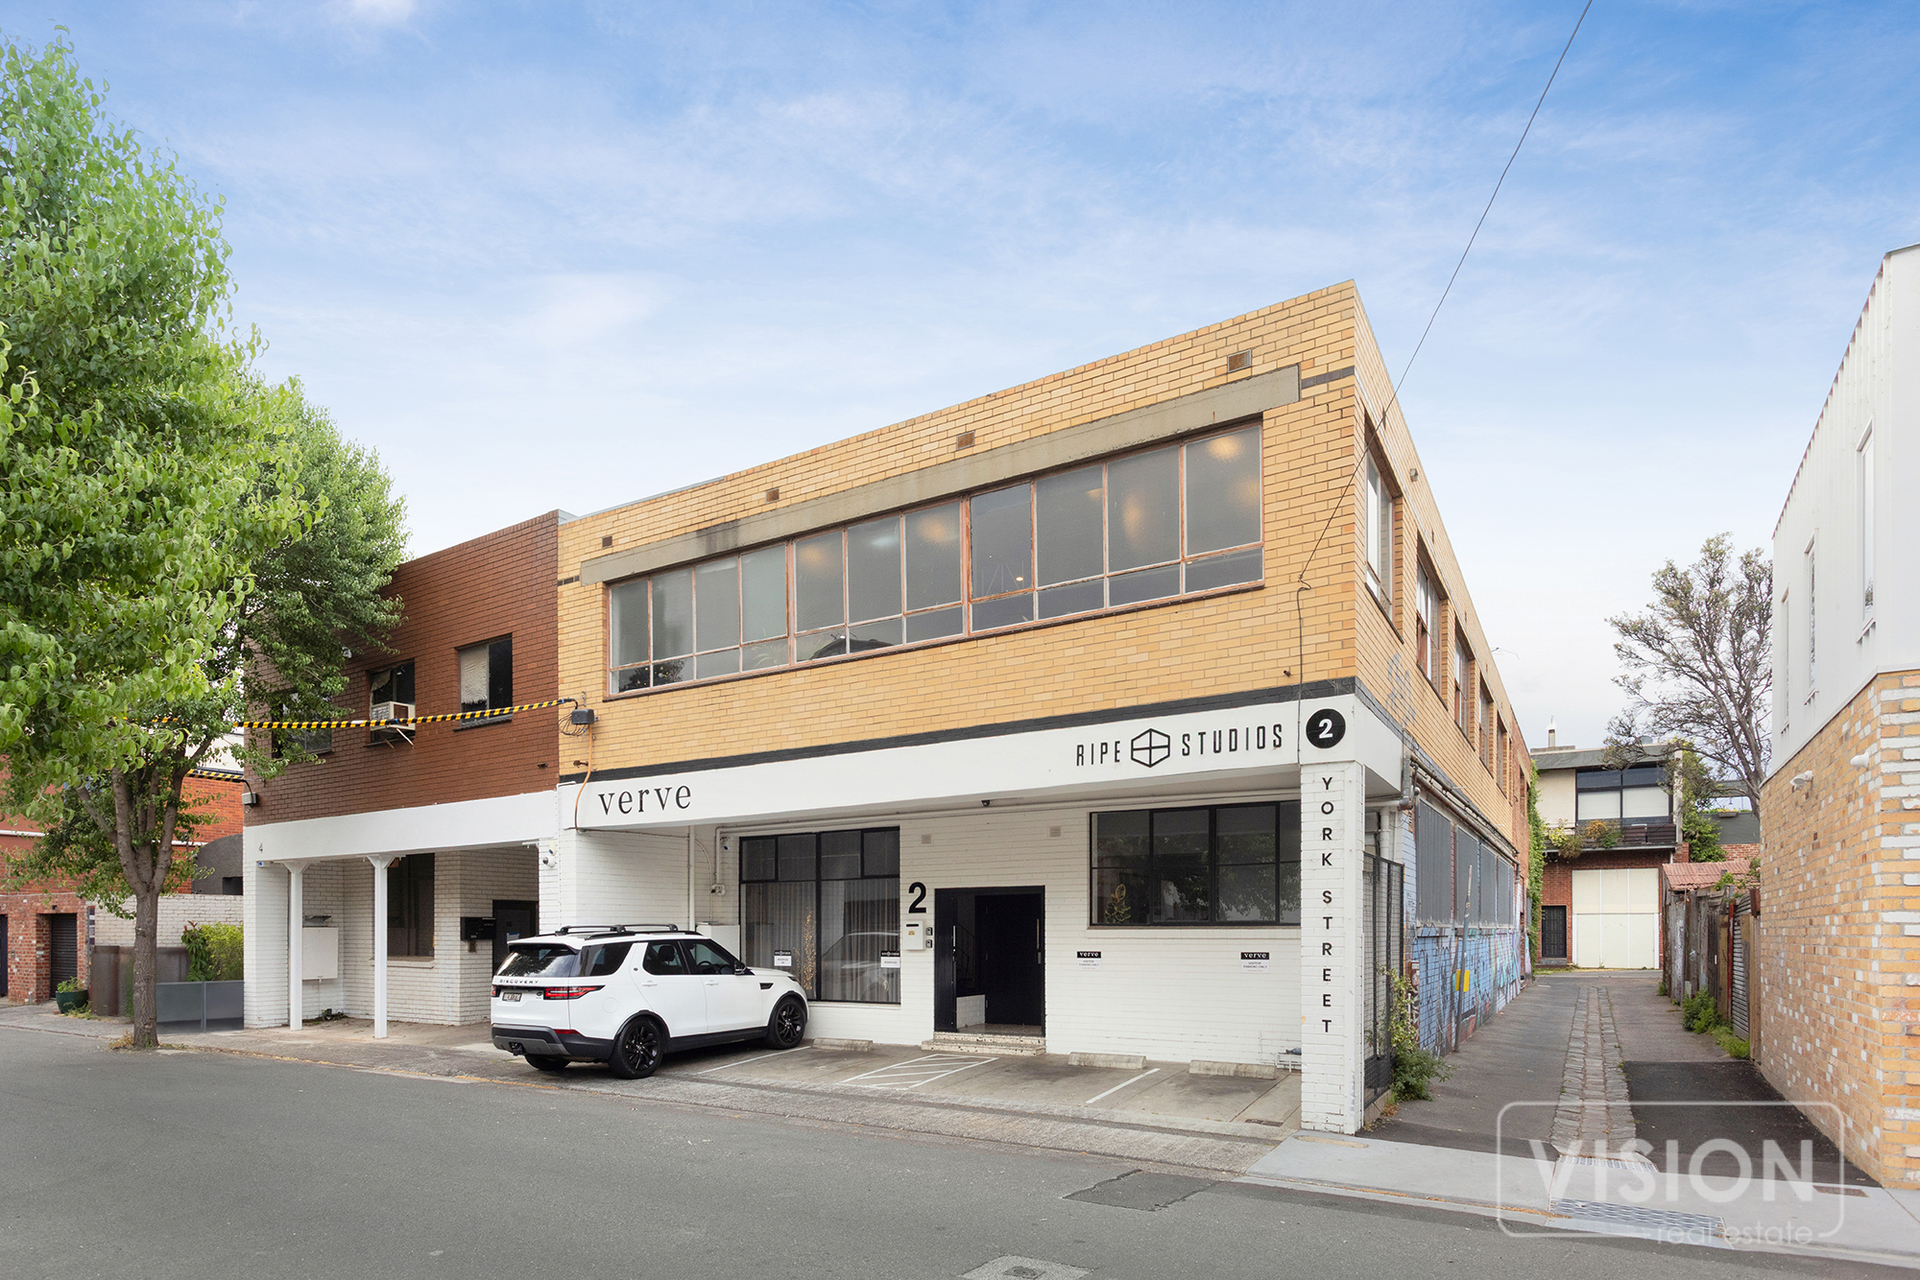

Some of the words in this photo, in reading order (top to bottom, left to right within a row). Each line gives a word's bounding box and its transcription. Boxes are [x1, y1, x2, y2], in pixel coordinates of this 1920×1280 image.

[1076, 740, 1121, 767] RIPE
[1181, 723, 1283, 757] STUDIOS
[1318, 718, 1334, 740] 2
[597, 785, 692, 815] verve
[1321, 776, 1335, 867] YORK
[908, 881, 927, 914] 2
[1321, 890, 1334, 1033] STREET
